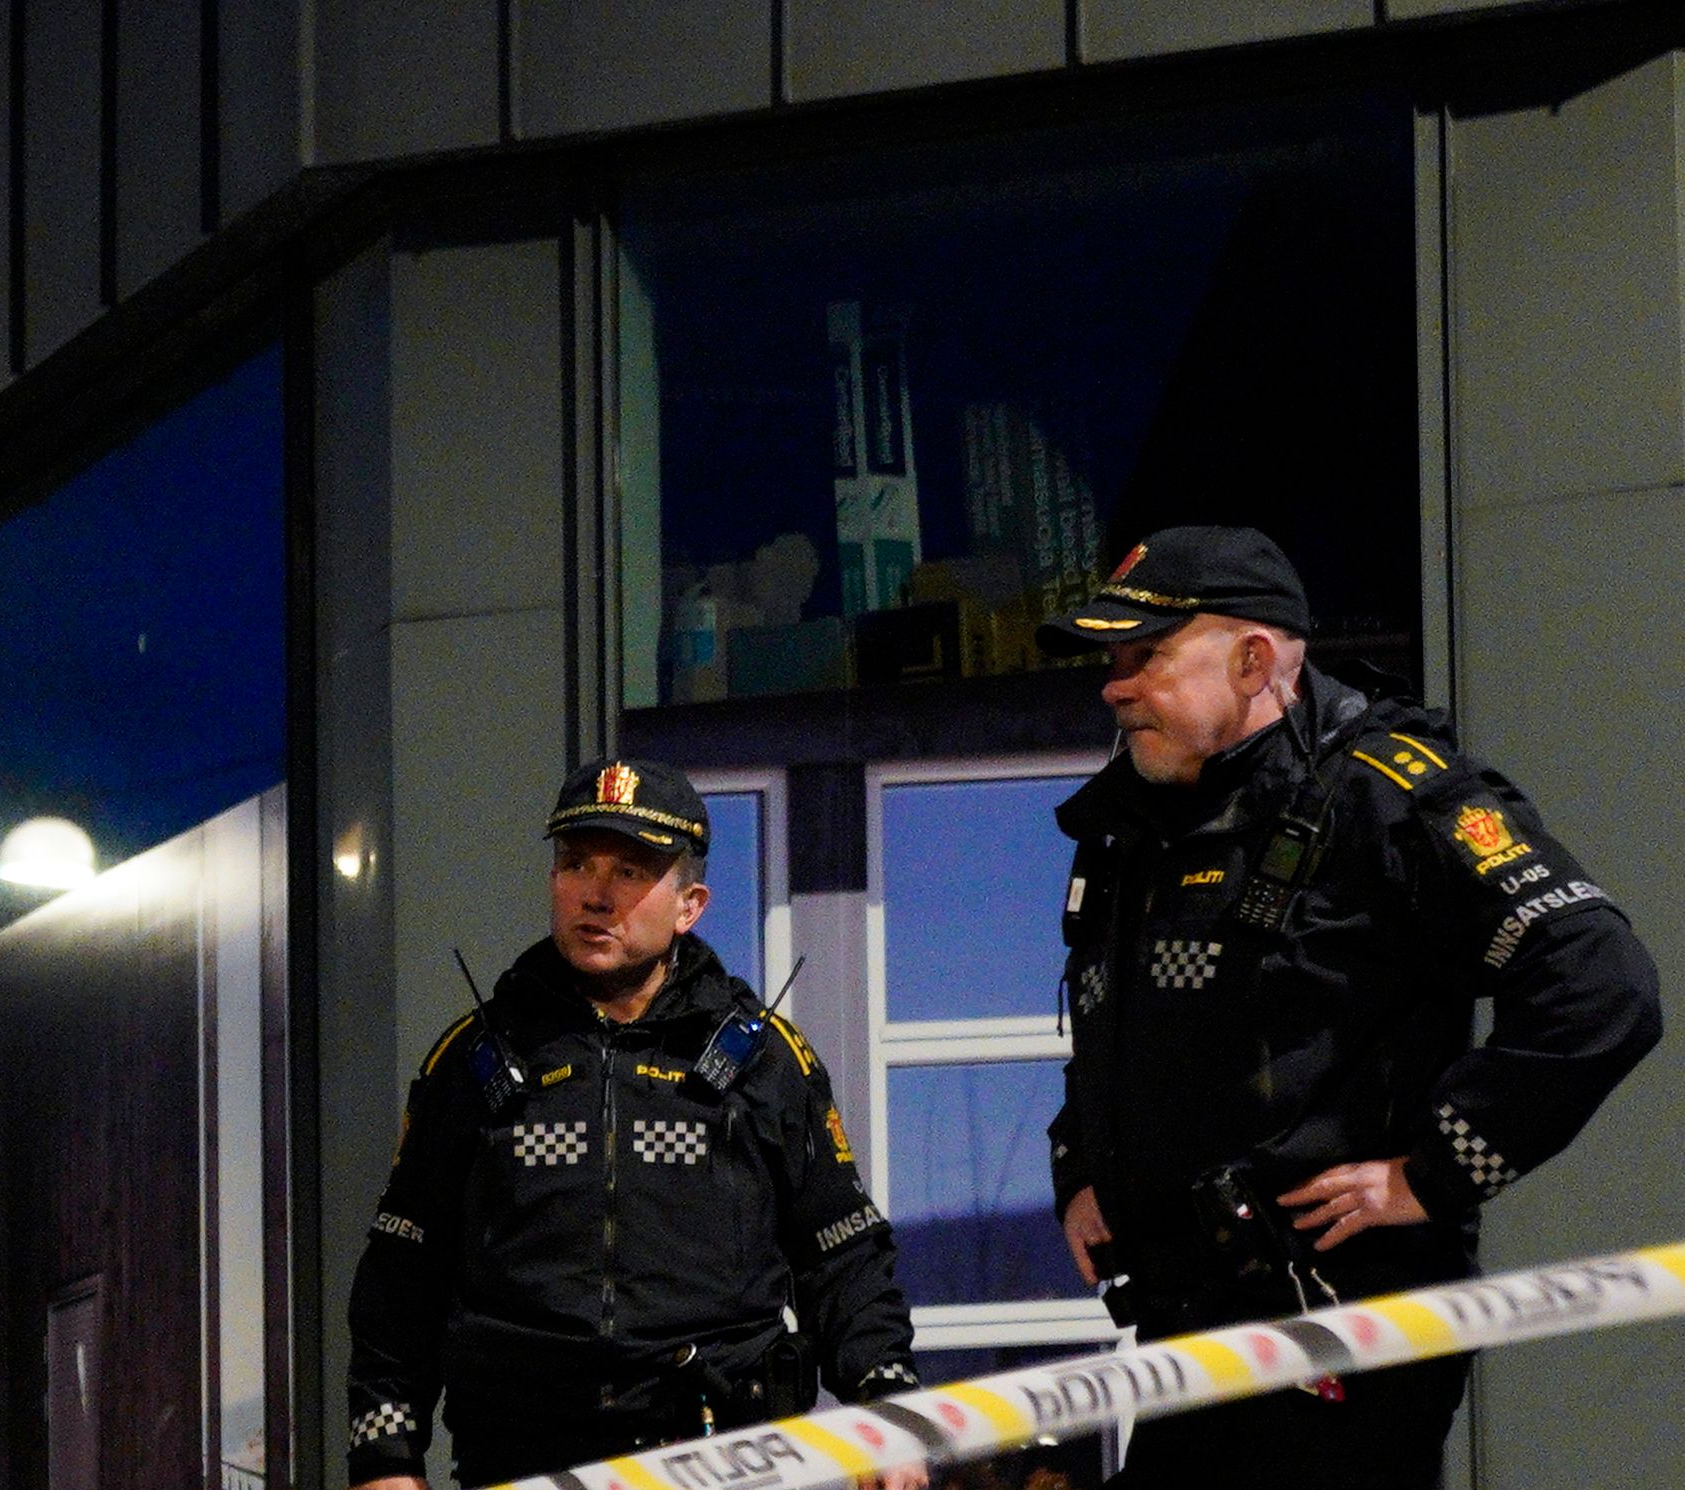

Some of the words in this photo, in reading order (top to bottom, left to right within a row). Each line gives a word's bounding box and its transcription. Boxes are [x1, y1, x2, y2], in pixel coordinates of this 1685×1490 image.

[1476, 843, 1532, 875] POLITI
[1500, 863, 1551, 895] U-05
[372, 1212, 425, 1244] EDER
[816, 1205, 880, 1252] INNSA
